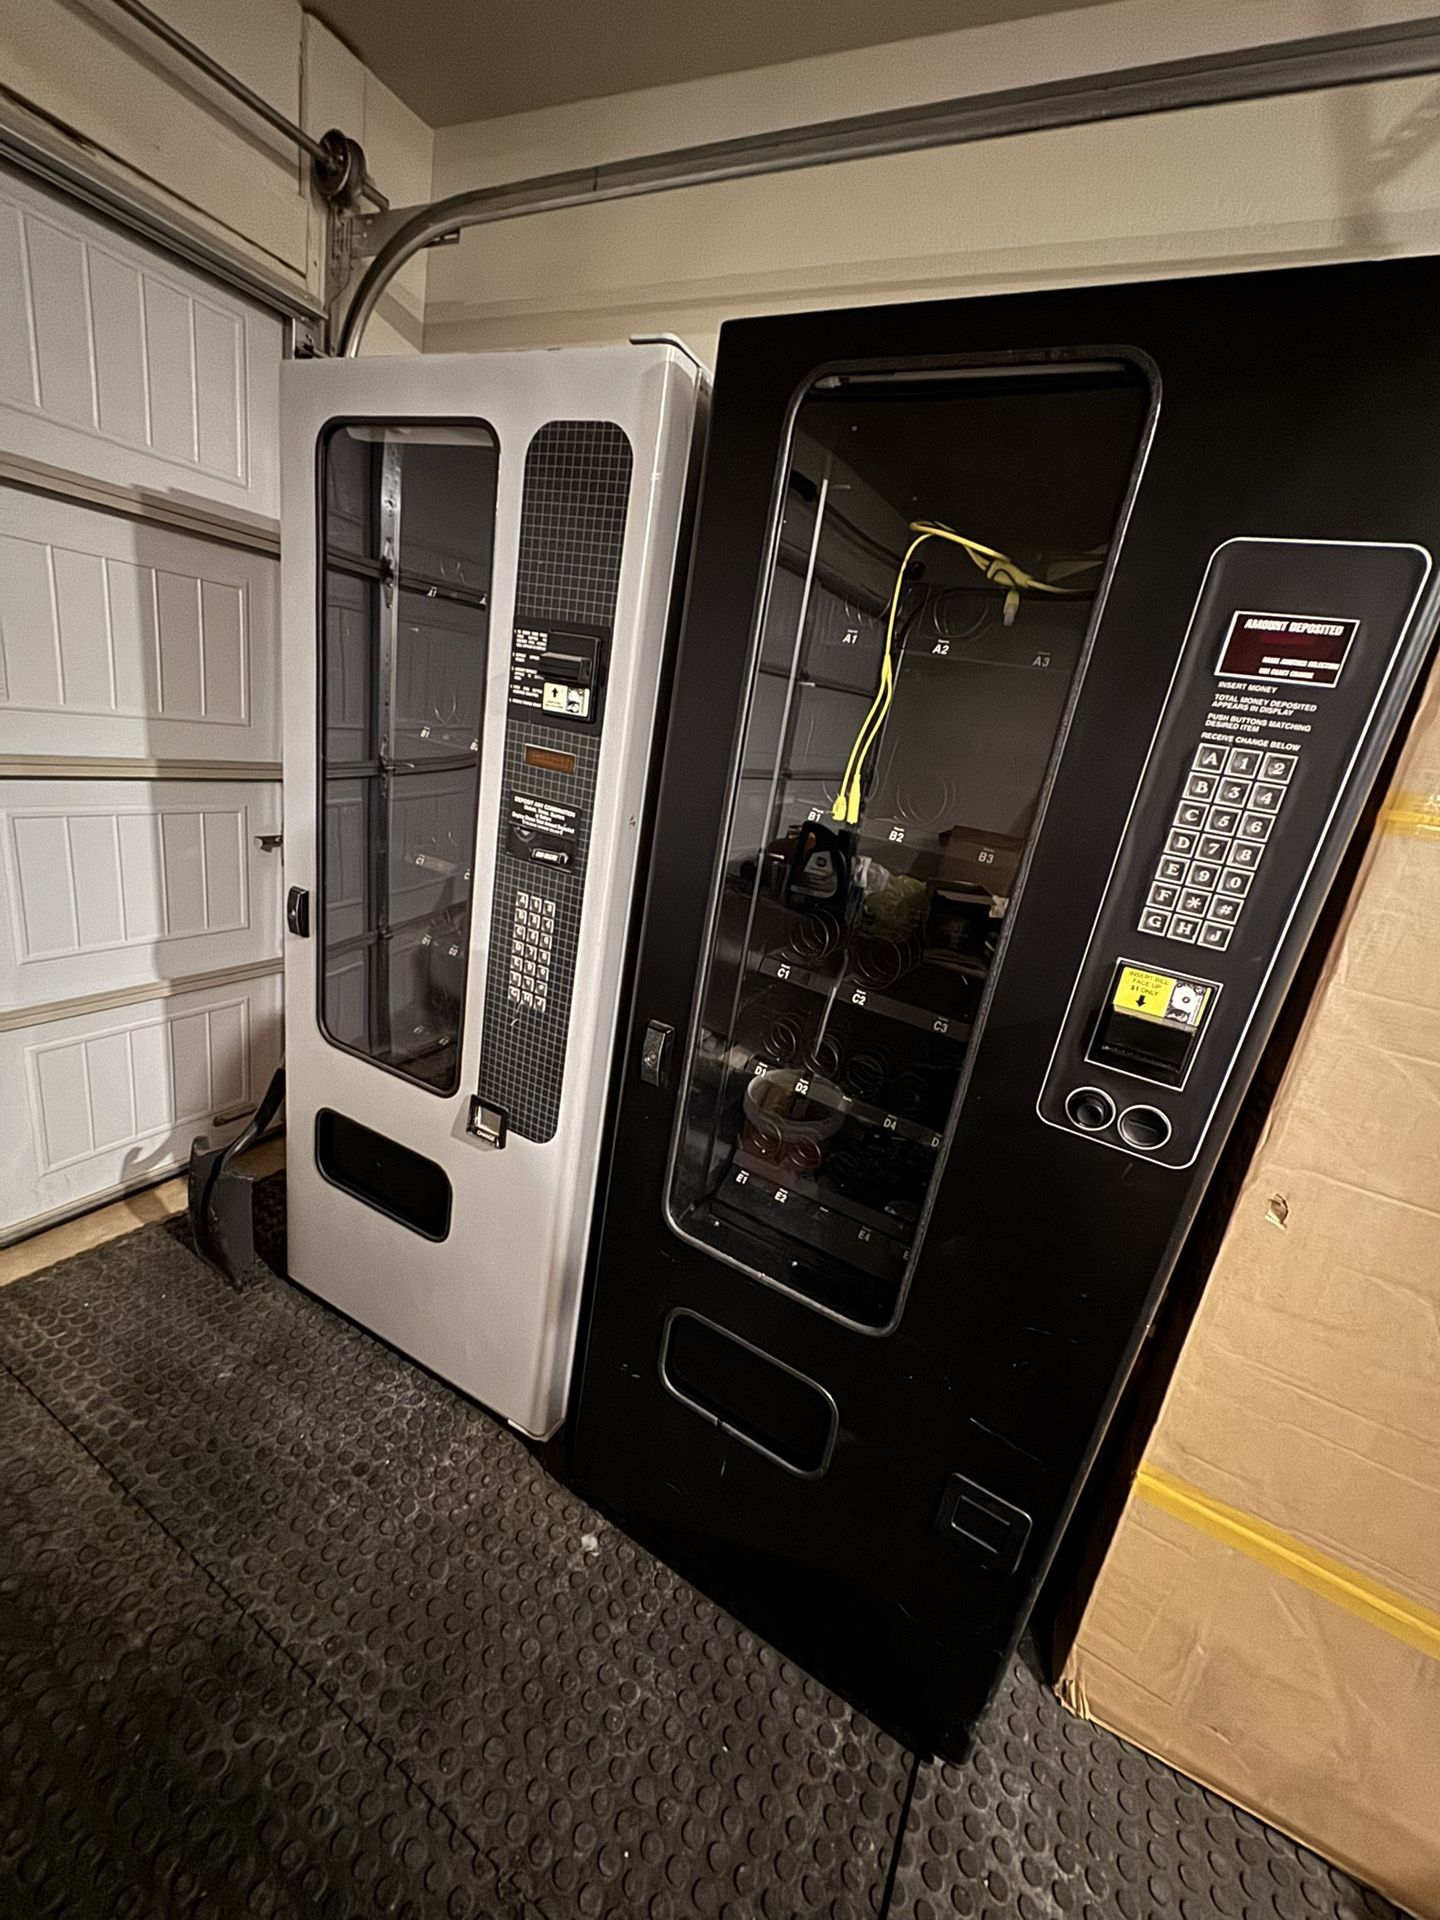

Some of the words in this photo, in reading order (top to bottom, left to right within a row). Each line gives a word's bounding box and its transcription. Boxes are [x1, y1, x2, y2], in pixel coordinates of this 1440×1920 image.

[1244, 619, 1289, 631] AMOUNT
[1288, 622, 1344, 636] DEPOSITED
[842, 634, 858, 645] A1
[932, 643, 950, 655] A2
[1033, 656, 1050, 667] A3
[1218, 681, 1247, 691] INSERT
[1248, 683, 1278, 694] MONEY
[1211, 701, 1248, 712] APPEARS
[1260, 706, 1294, 716] DISPLAY
[1214, 694, 1239, 703] TOTAL
[1240, 696, 1270, 707] MONEY
[1270, 700, 1317, 712] DEPOSITED
[1205, 720, 1239, 731] DESIRED
[1240, 724, 1260, 733] ITEM
[1208, 713, 1229, 722] PUSH
[1230, 715, 1267, 727] BUTTONS
[1268, 720, 1311, 732] MATCHING
[1201, 732, 1234, 743] RECEIVE
[1235, 736, 1269, 747] CHANGE
[1270, 741, 1301, 751] BELOW
[1203, 752, 1218, 766] A
[1240, 758, 1249, 770] 1
[1271, 763, 1285, 775] 2
[1195, 781, 1208, 793] B
[1229, 787, 1241, 798] 3
[1260, 792, 1273, 804] 4
[807, 811, 821, 823] B1
[1185, 809, 1199, 821] C
[1218, 816, 1230, 827] 5
[1250, 821, 1263, 833] 6
[889, 830, 905, 843] B2
[1176, 837, 1190, 848] D
[1208, 843, 1220, 855] 7
[1239, 849, 1252, 861] 8
[978, 852, 995, 864] B3
[1166, 864, 1180, 876] E
[1199, 870, 1210, 882] 9
[1229, 877, 1242, 888] 0
[1158, 890, 1172, 901] F
[1149, 916, 1162, 928] G
[1176, 922, 1193, 935] H
[1210, 930, 1222, 942] J
[777, 968, 790, 980] C1
[1129, 971, 1153, 981] INSERT
[1154, 975, 1169, 985] BILL
[1132, 978, 1150, 987] FACE
[1140, 987, 1160, 997] ONLY
[852, 993, 866, 1006] C2
[933, 1020, 948, 1033] C3
[754, 1066, 767, 1077] D1
[795, 1082, 809, 1095] D2
[883, 1118, 897, 1131] D4
[736, 1174, 748, 1185] E1
[774, 1191, 787, 1203] E2
[858, 1230, 871, 1241] E4
